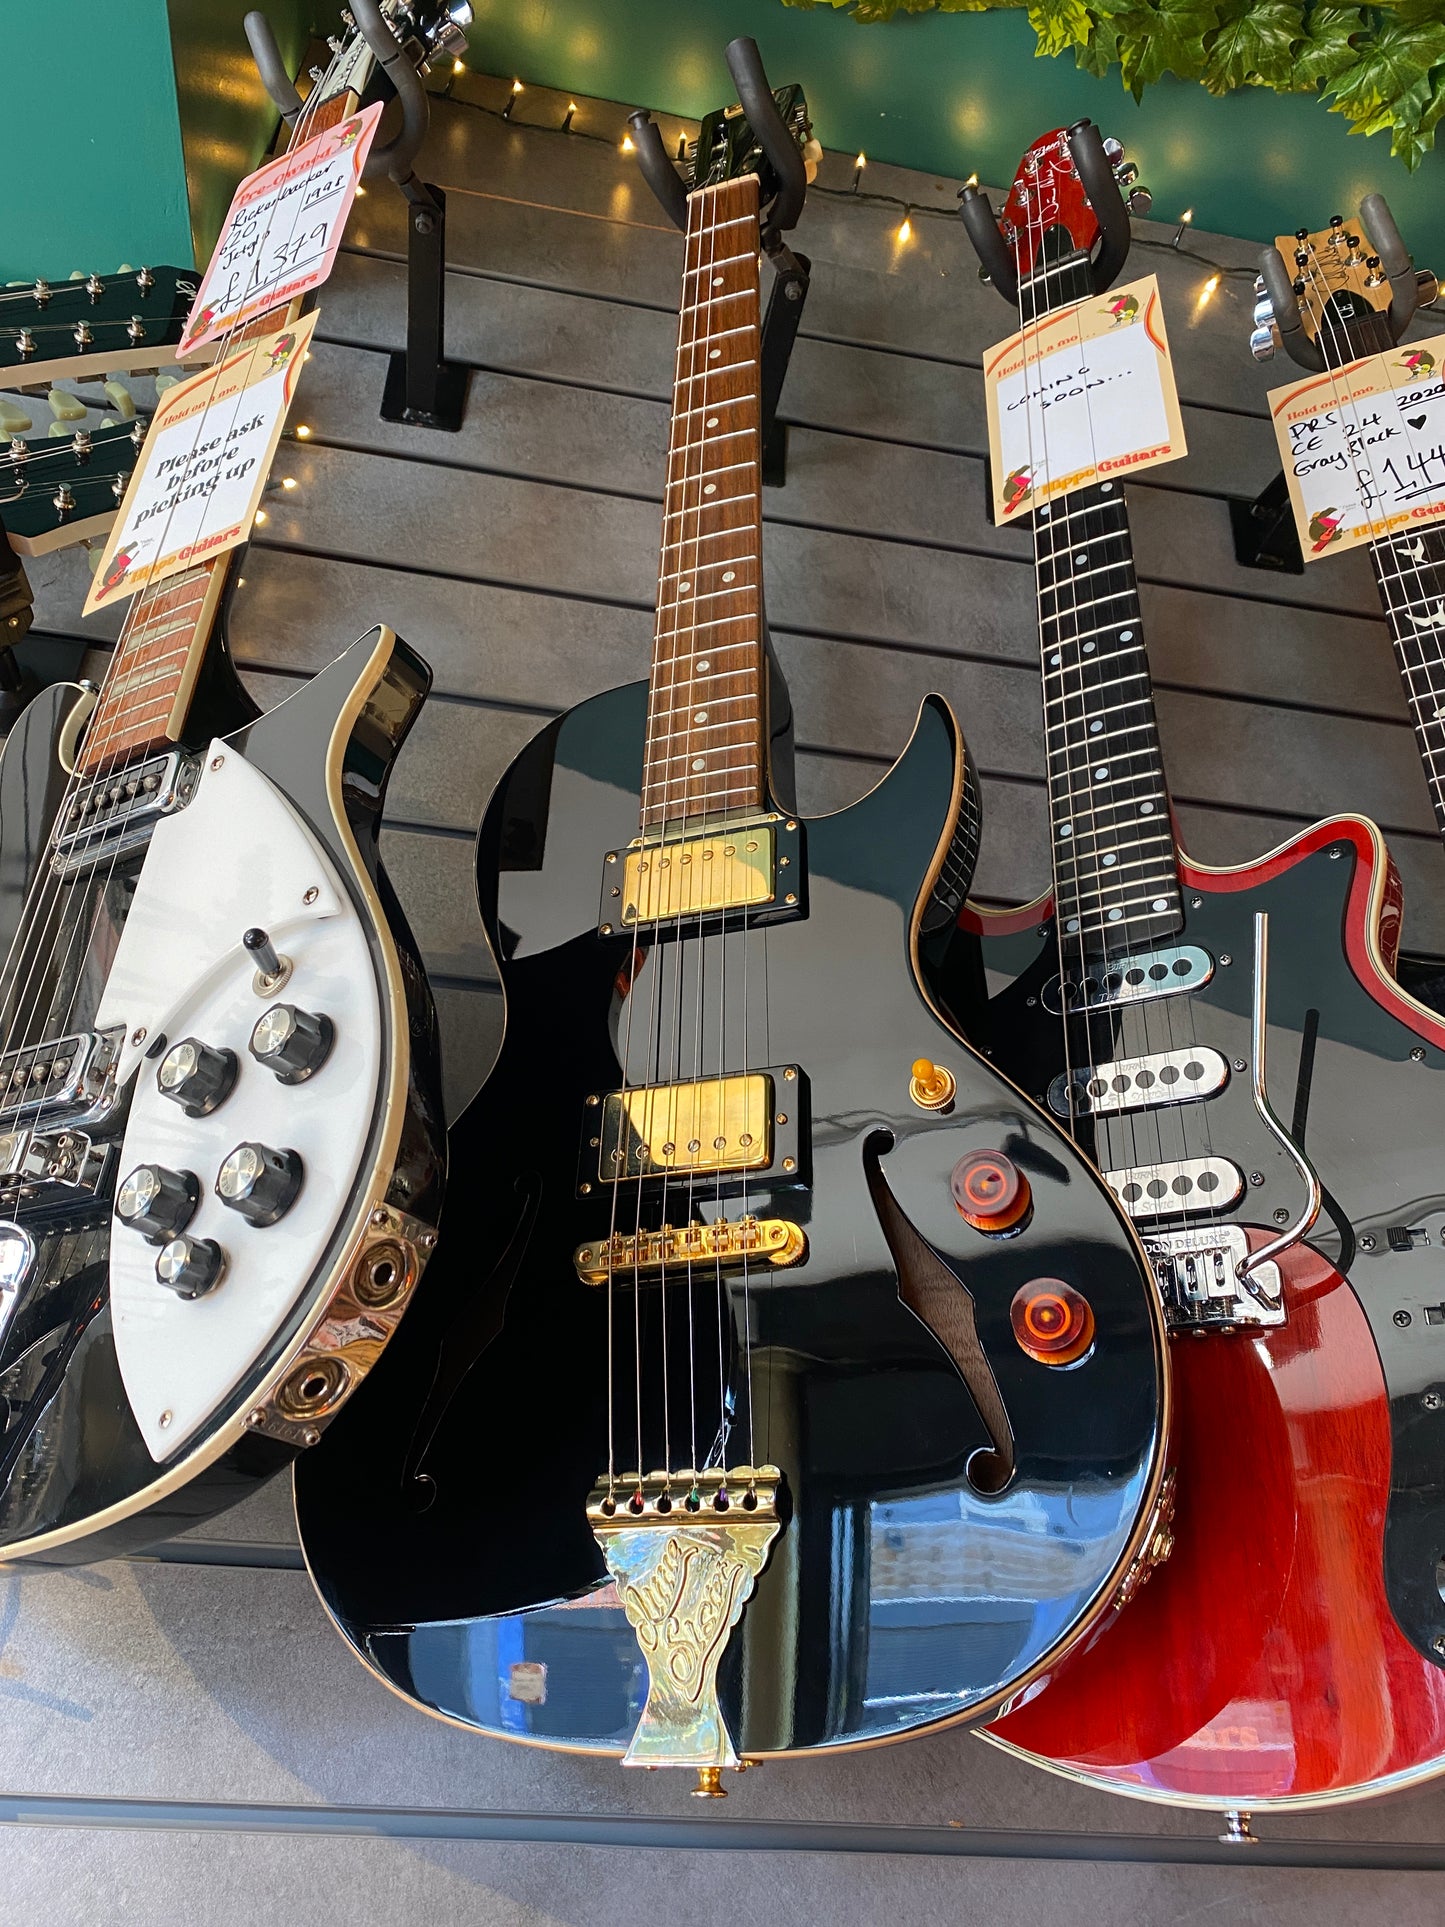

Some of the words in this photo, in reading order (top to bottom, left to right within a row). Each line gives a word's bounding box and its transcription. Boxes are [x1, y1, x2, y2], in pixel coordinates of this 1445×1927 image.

[238, 147, 333, 205] Pre-Owned
[304, 175, 345, 207] 1998
[230, 160, 335, 231] Rickenbacker
[219, 221, 257, 256] 620
[259, 272, 320, 306] Guitars
[997, 357, 1026, 378] Hold
[1028, 350, 1044, 362] on
[1046, 343, 1055, 351] a
[1006, 366, 1091, 411] COMING
[1396, 383, 1445, 407] 2020
[162, 409, 190, 427] Hold
[191, 399, 206, 415] on
[1286, 404, 1318, 421] Hold
[1321, 399, 1338, 410] on
[1341, 395, 1350, 403] a
[1289, 412, 1338, 440] PRS
[1291, 436, 1323, 456] CE
[1343, 413, 1382, 440] 24
[155, 435, 221, 479] Please
[225, 413, 265, 443] ask
[165, 445, 240, 492] before
[1041, 467, 1096, 496] Hippo
[1097, 444, 1172, 473] Guitars
[132, 471, 223, 531] picking
[225, 456, 256, 485] up
[1353, 513, 1410, 539] Hippo
[129, 554, 178, 584] Hippo
[178, 524, 242, 562] Guitars
[120, 1184, 131, 1207] TONE
[137, 1173, 153, 1208] TREBLE
